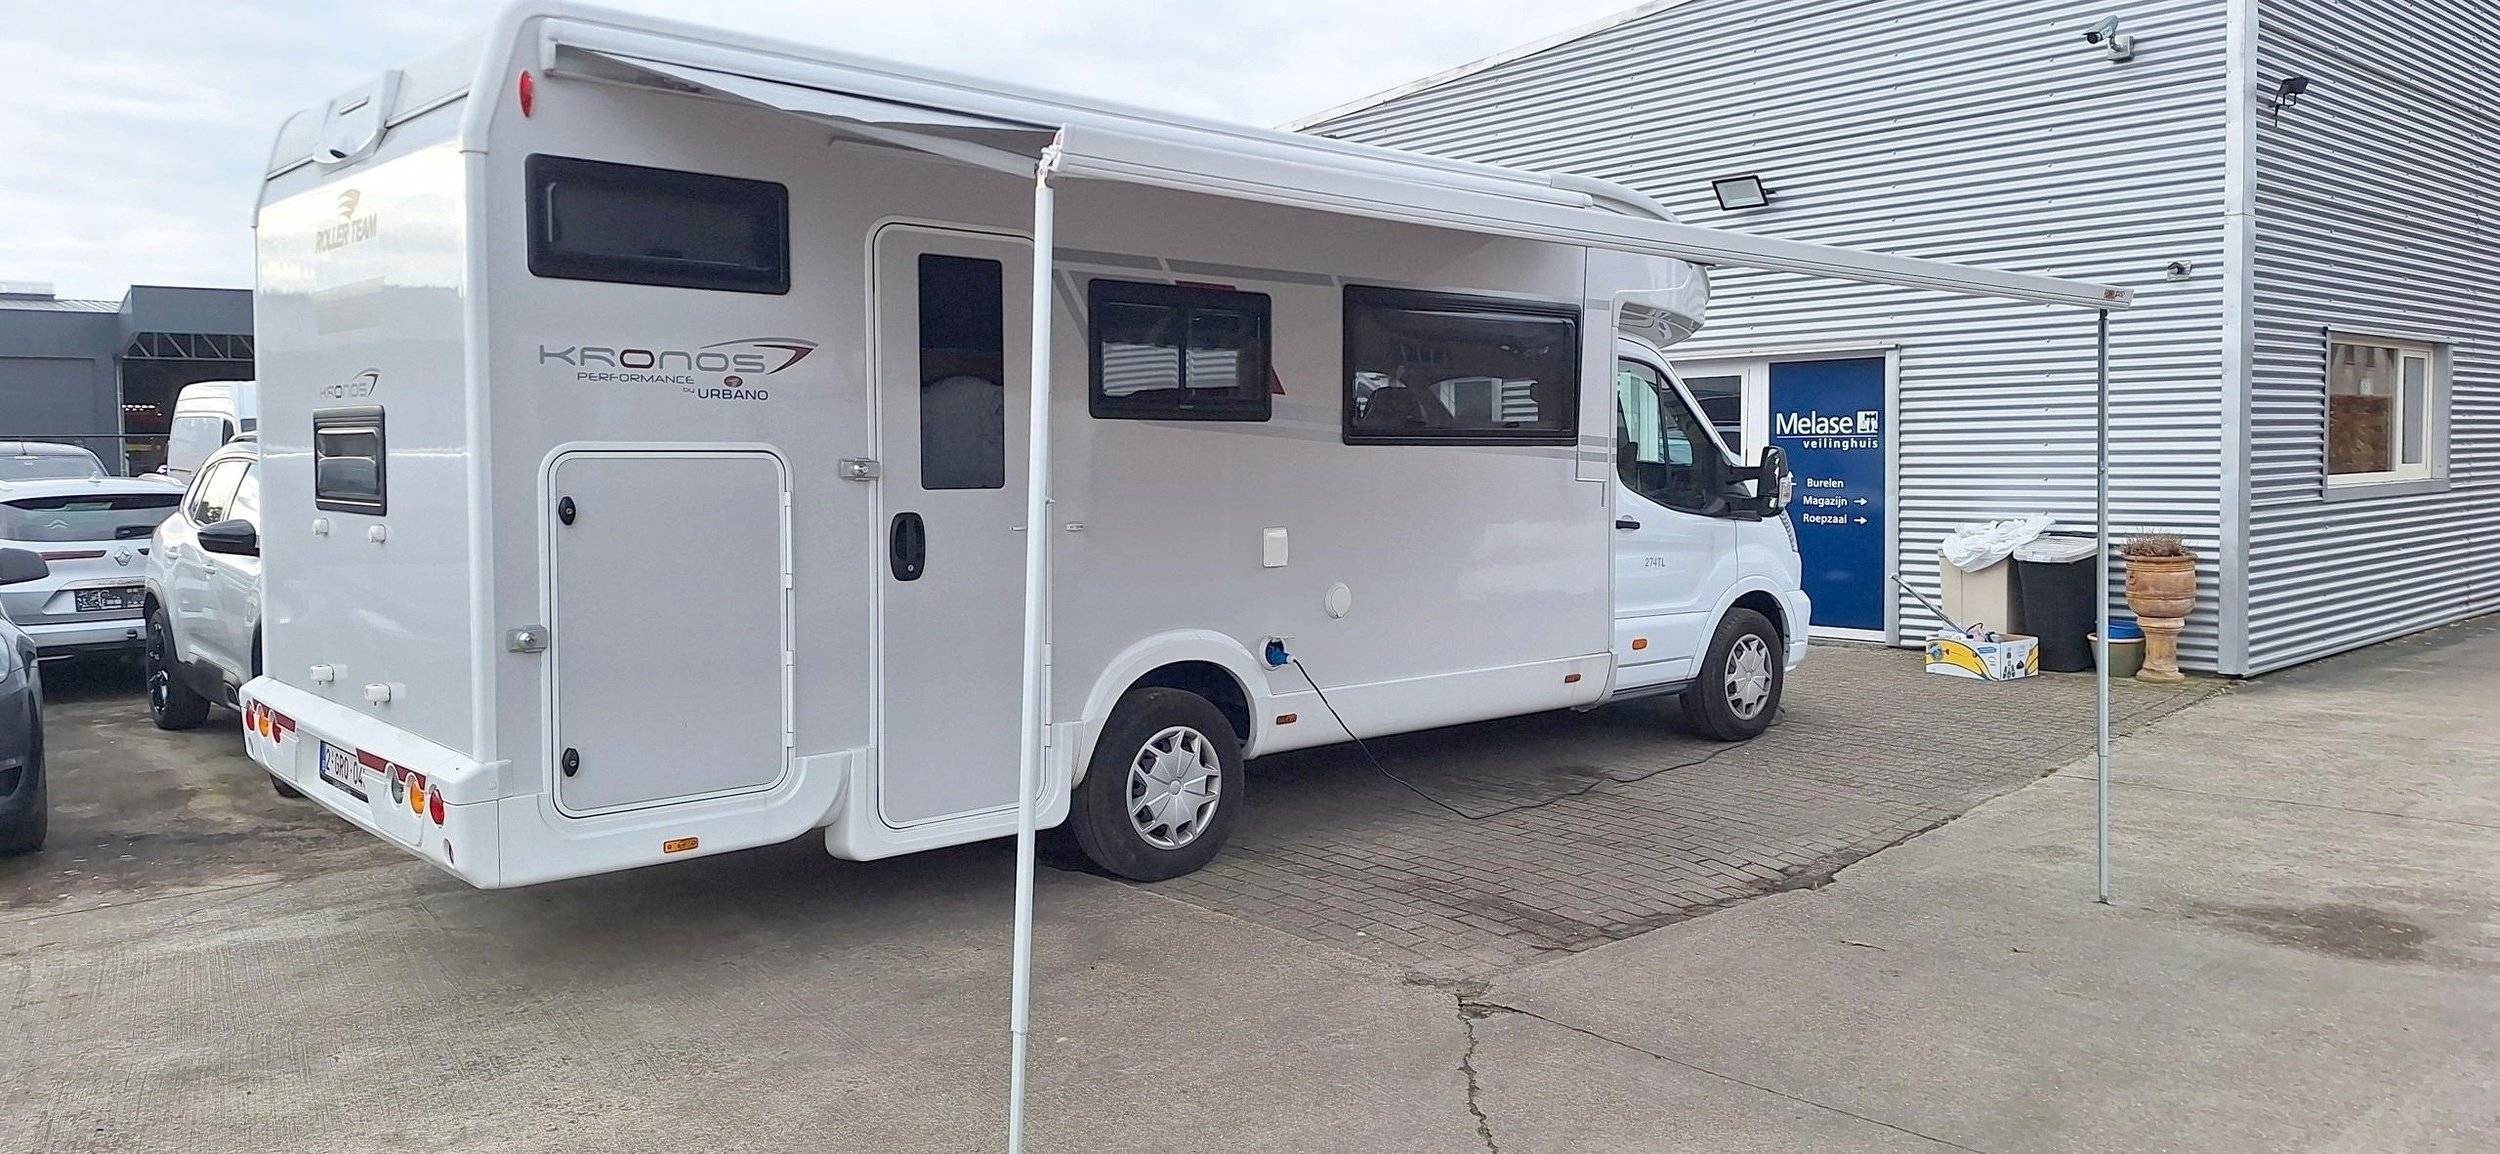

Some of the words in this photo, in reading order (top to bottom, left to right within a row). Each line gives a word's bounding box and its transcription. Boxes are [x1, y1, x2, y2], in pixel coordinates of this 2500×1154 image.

[315, 222, 349, 254] ROLLER
[351, 212, 378, 243] TEAM
[539, 344, 766, 373] KRONOS
[576, 371, 695, 385] PERFORMANCE
[682, 386, 695, 394] by
[697, 387, 769, 401] URBANO
[1776, 411, 1854, 435] Melase
[1803, 438, 1879, 451] veilinghuis
[1806, 478, 1845, 488] Burelen
[1803, 495, 1848, 508] Magazijn
[1803, 513, 1848, 525] Roepzaal
[1644, 557, 1666, 567] 274TL
